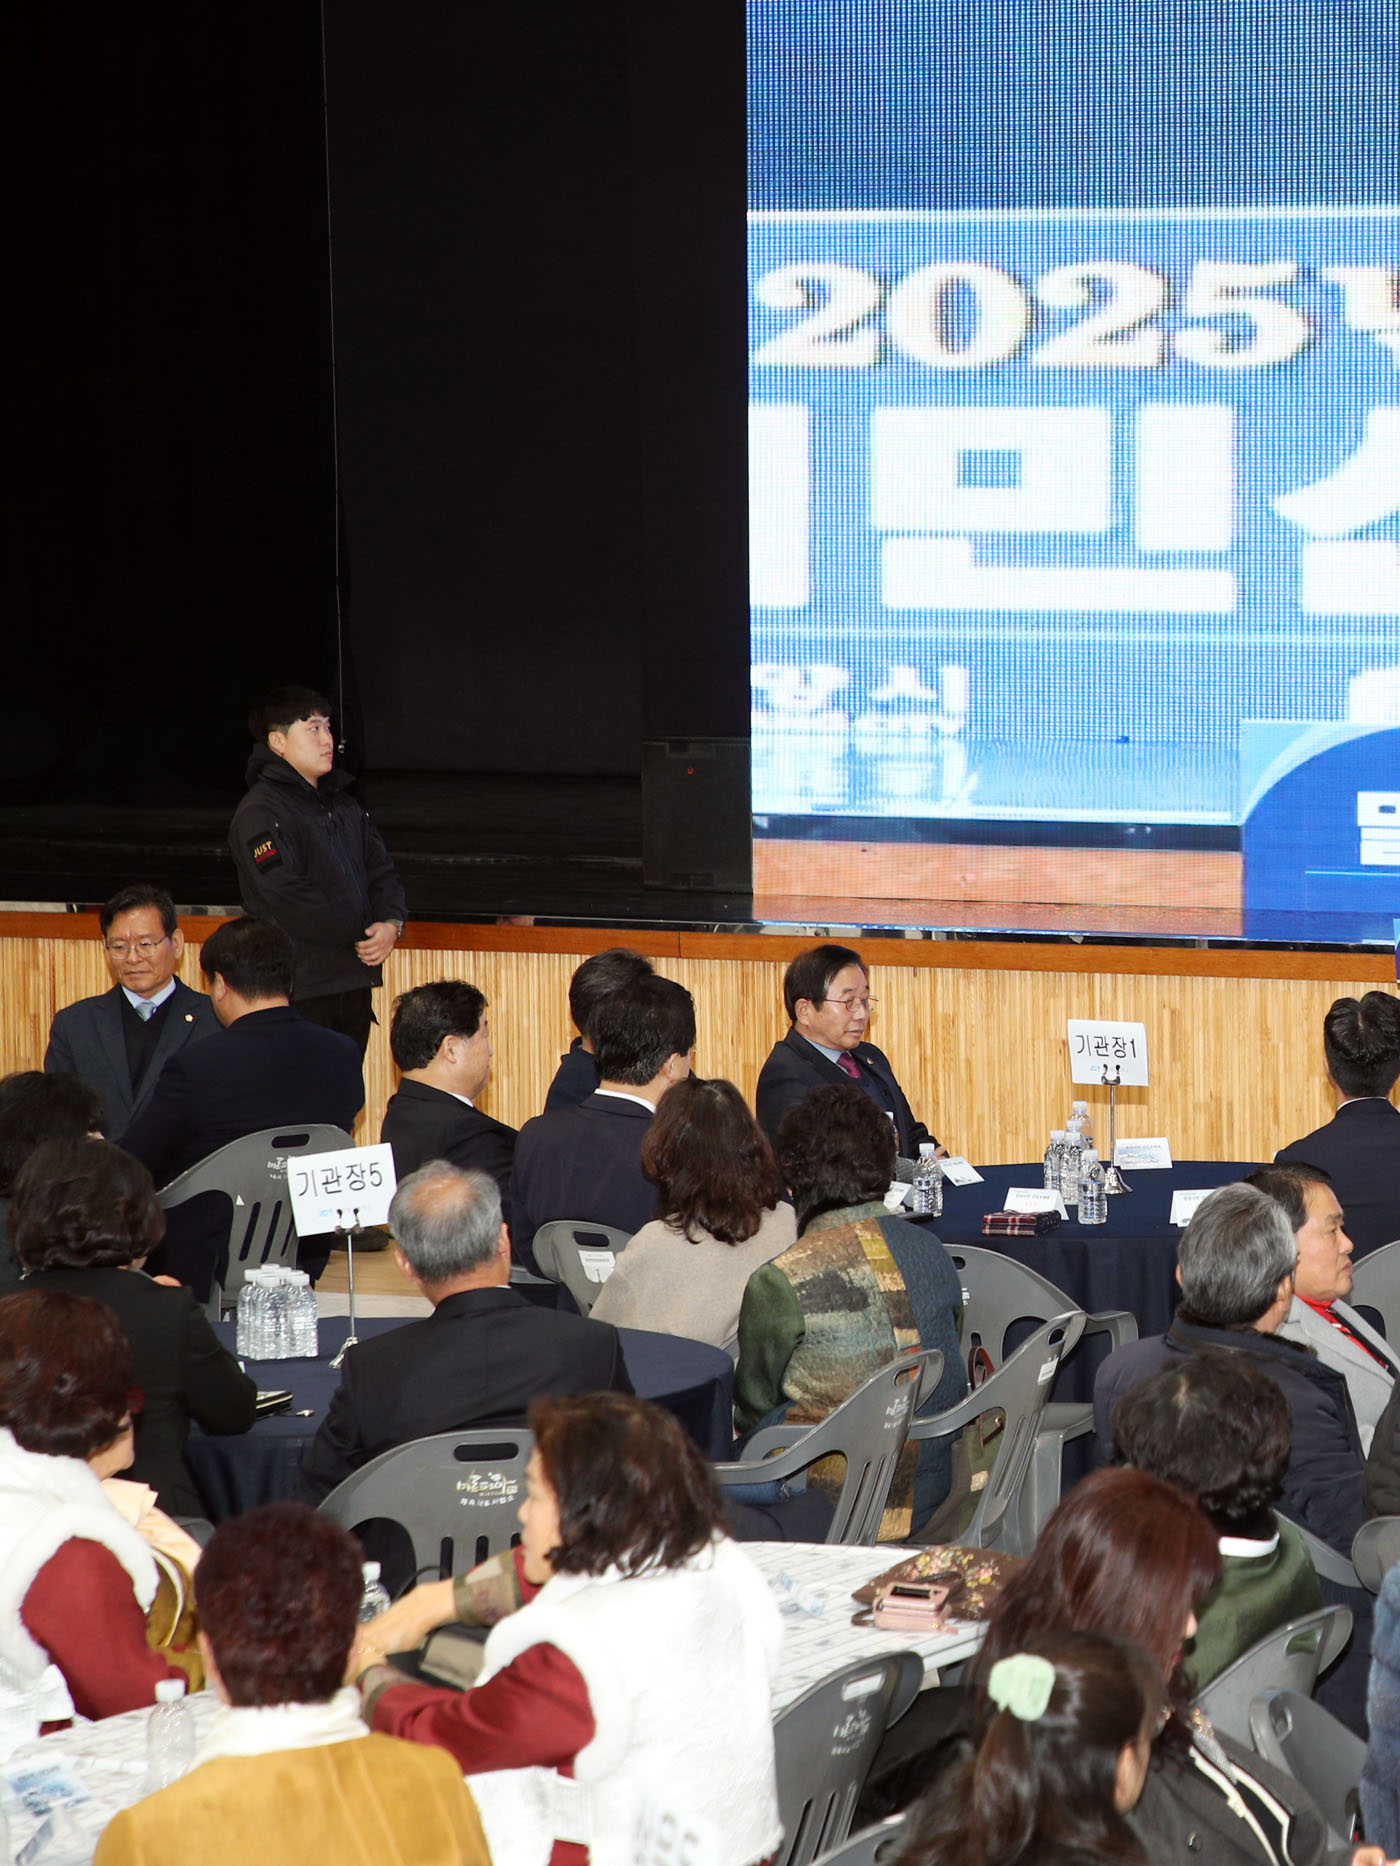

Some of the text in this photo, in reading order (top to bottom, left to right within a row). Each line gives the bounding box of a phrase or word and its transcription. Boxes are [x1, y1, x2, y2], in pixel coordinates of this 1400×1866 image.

[254, 841, 272, 858] JUST
[1075, 1034, 1137, 1059] 기관장1
[296, 1161, 383, 1198] 기관장5
